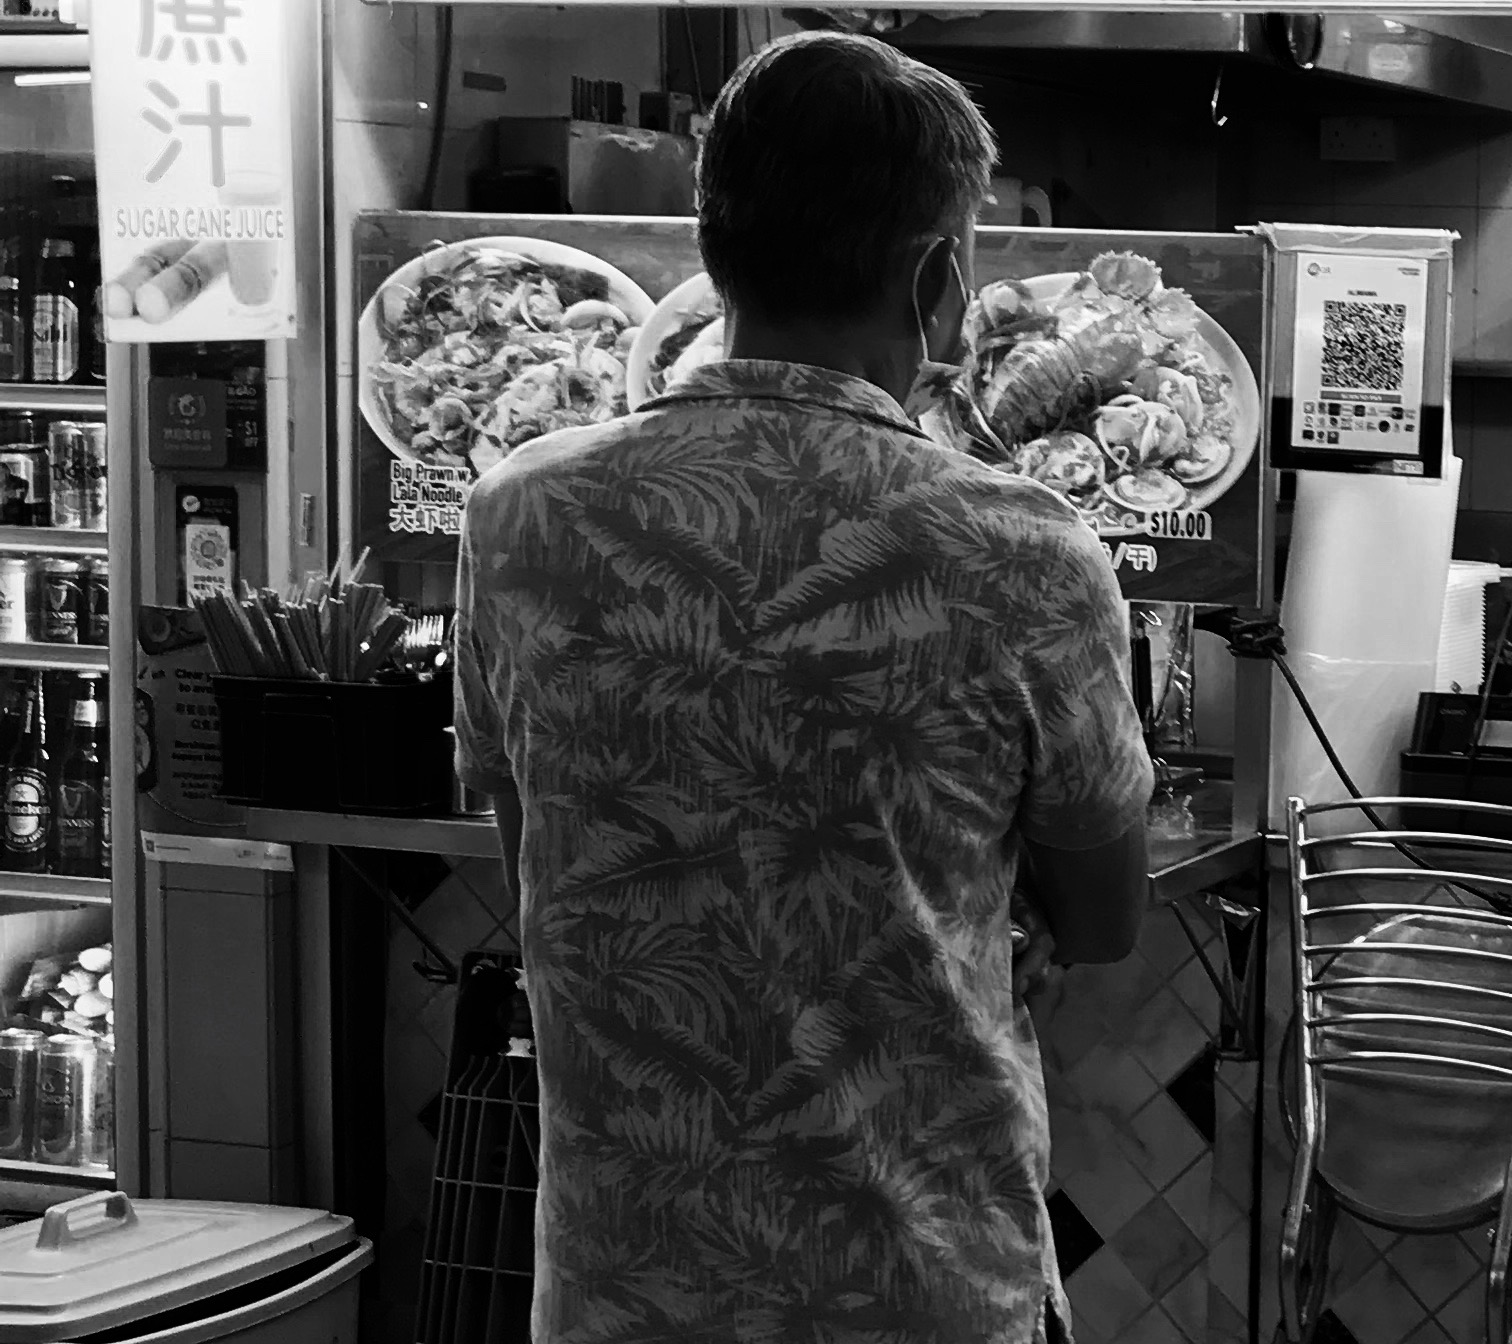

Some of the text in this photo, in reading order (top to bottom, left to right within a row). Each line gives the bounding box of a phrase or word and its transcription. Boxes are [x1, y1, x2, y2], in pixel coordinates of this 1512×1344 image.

[115, 208, 284, 239] SUGAR CANE JUICE
[393, 462, 412, 484] Big
[416, 463, 454, 482] Prawn
[393, 482, 463, 503] Lala Noodle
[1150, 512, 1206, 538] $10.00
